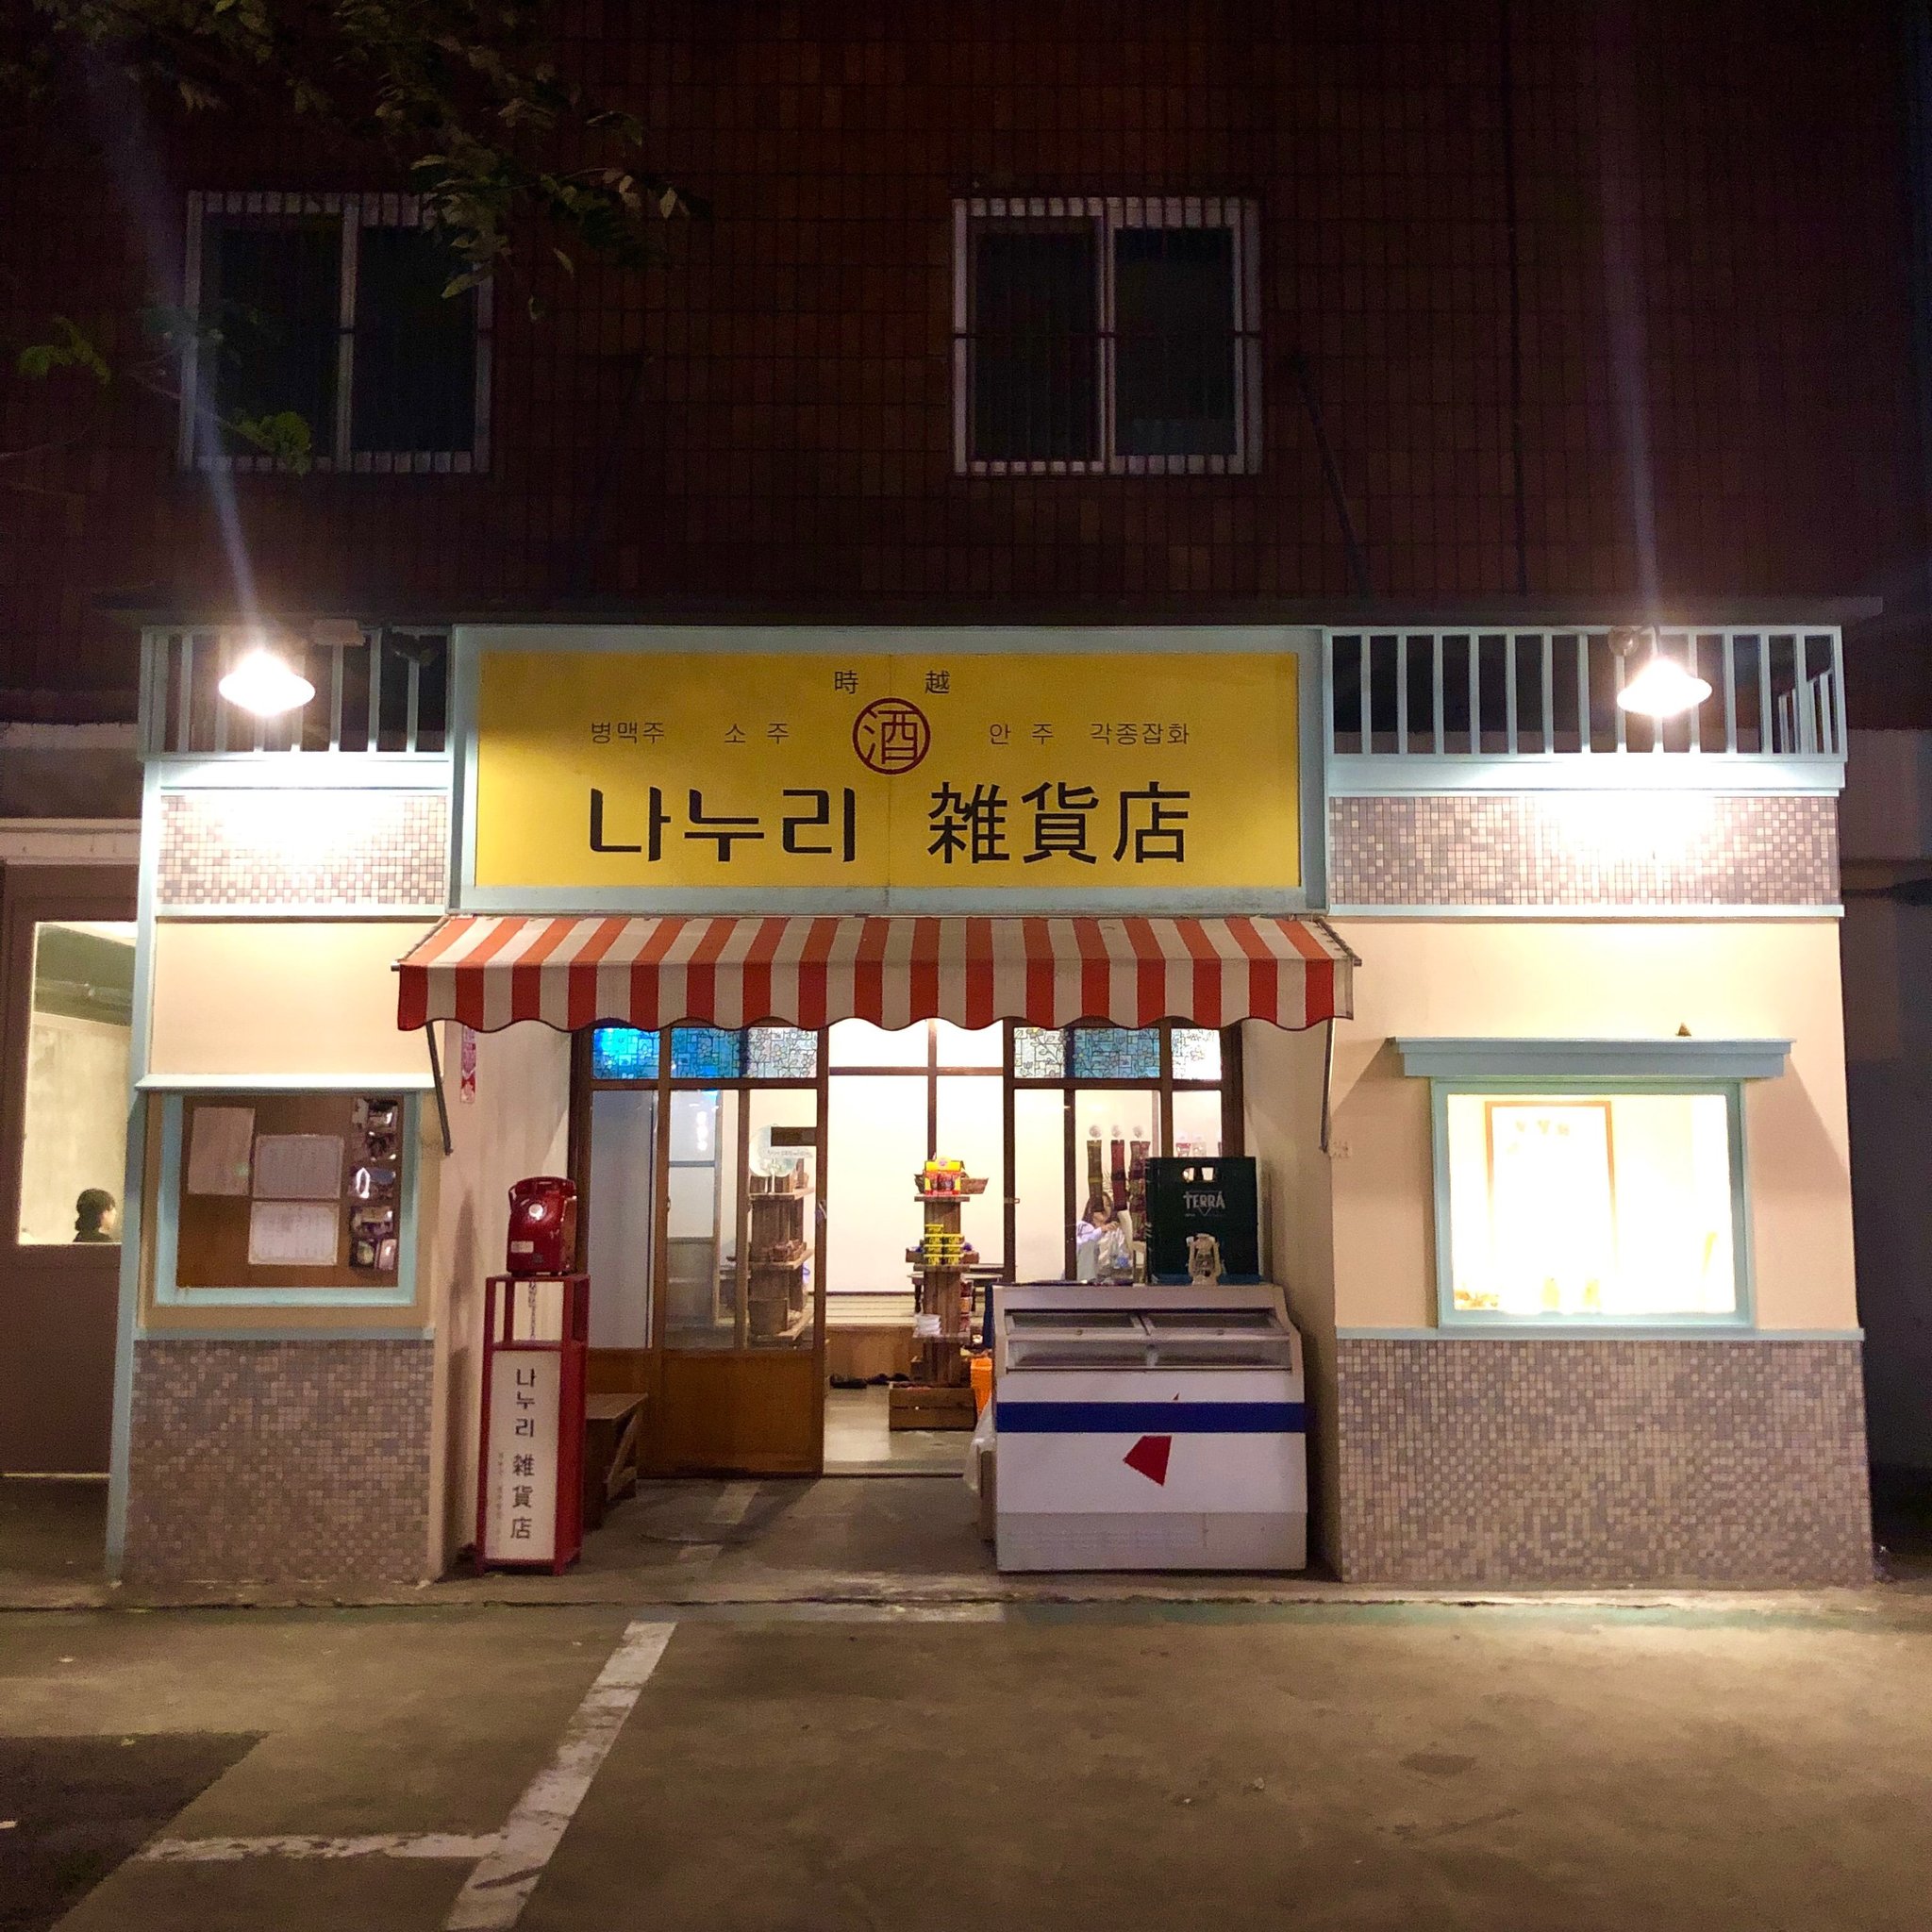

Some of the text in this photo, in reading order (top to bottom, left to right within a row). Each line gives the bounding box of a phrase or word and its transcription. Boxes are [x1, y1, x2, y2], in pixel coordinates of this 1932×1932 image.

[833, 670, 951, 694] 時 越
[591, 722, 665, 744] 병맥주
[861, 708, 921, 765] 酒
[1090, 723, 1190, 745] 각종잡화
[590, 787, 856, 862] 나누리
[1182, 1190, 1226, 1209] TERRA
[515, 1368, 536, 1438] 나누리
